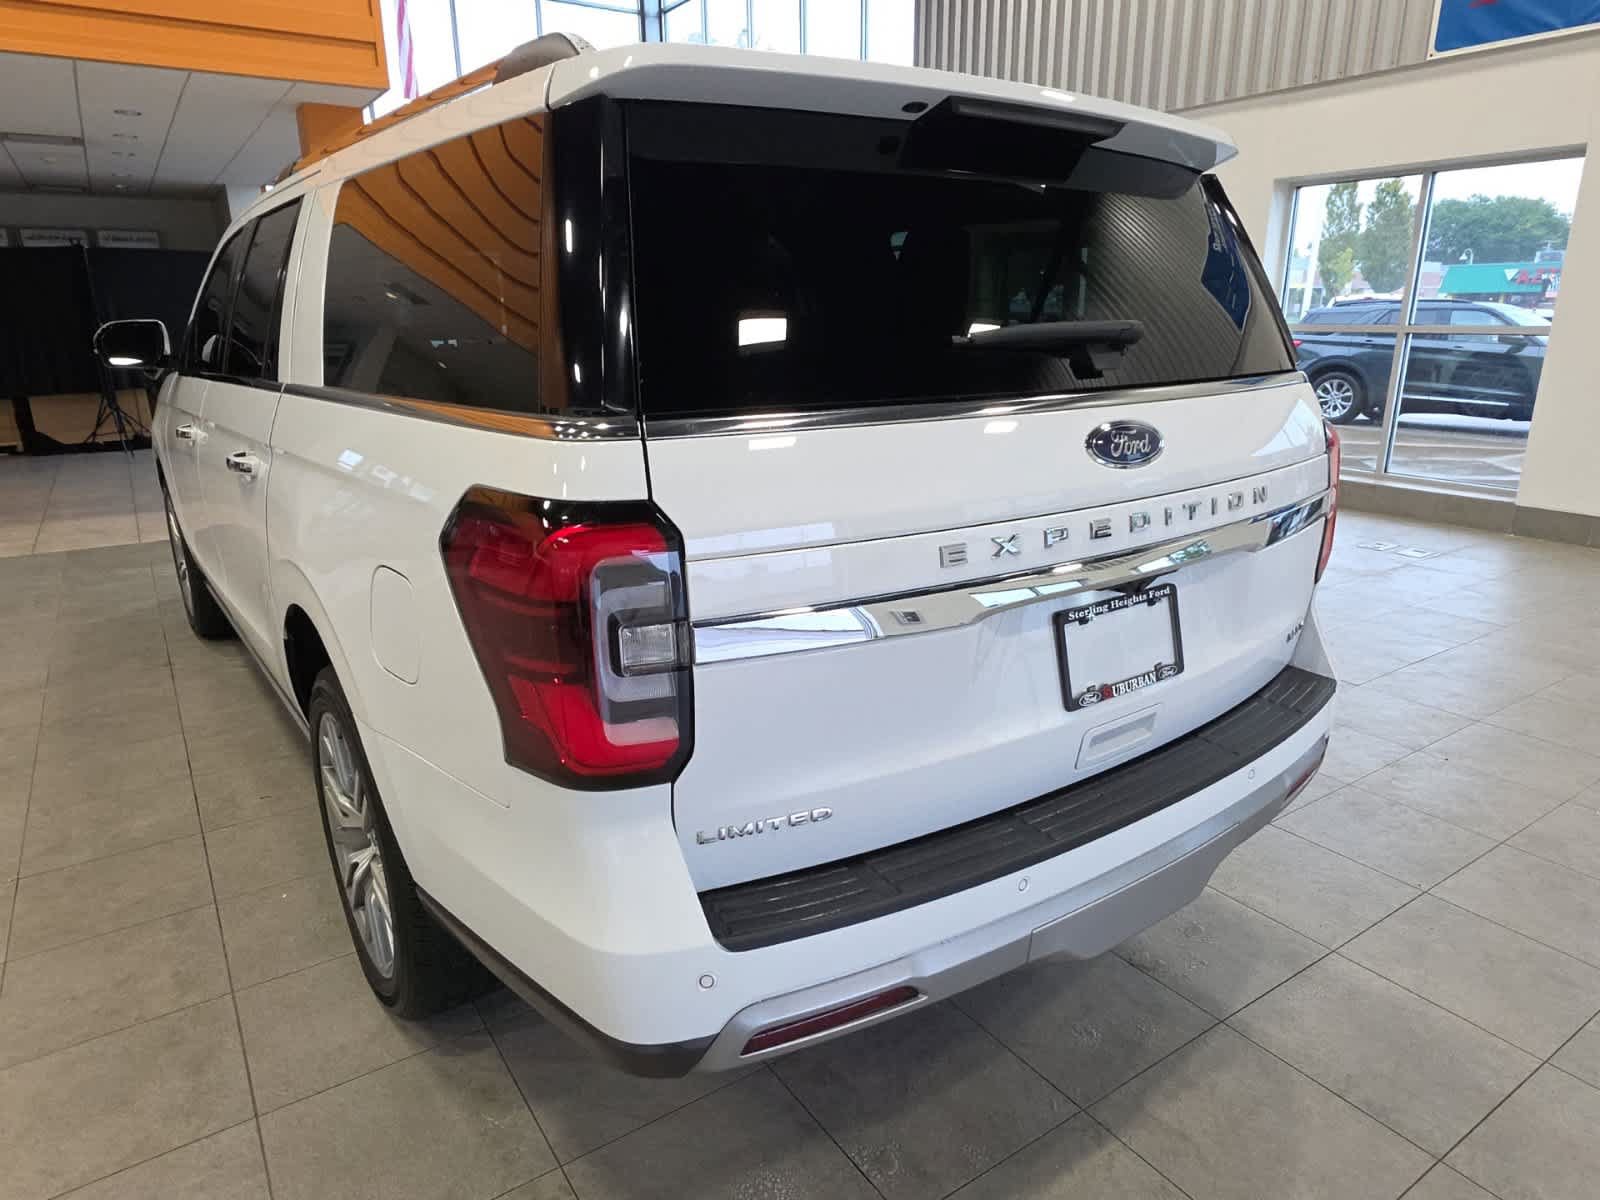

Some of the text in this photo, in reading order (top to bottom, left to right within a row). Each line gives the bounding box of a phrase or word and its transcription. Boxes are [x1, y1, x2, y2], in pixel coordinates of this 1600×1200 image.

[1110, 429, 1151, 457] Ford
[939, 485, 1268, 568] EXPEDITION
[1068, 586, 1170, 620] Sterling Heights Ford
[1103, 671, 1157, 699] SUBURBAN
[696, 807, 833, 845] LIMITED
